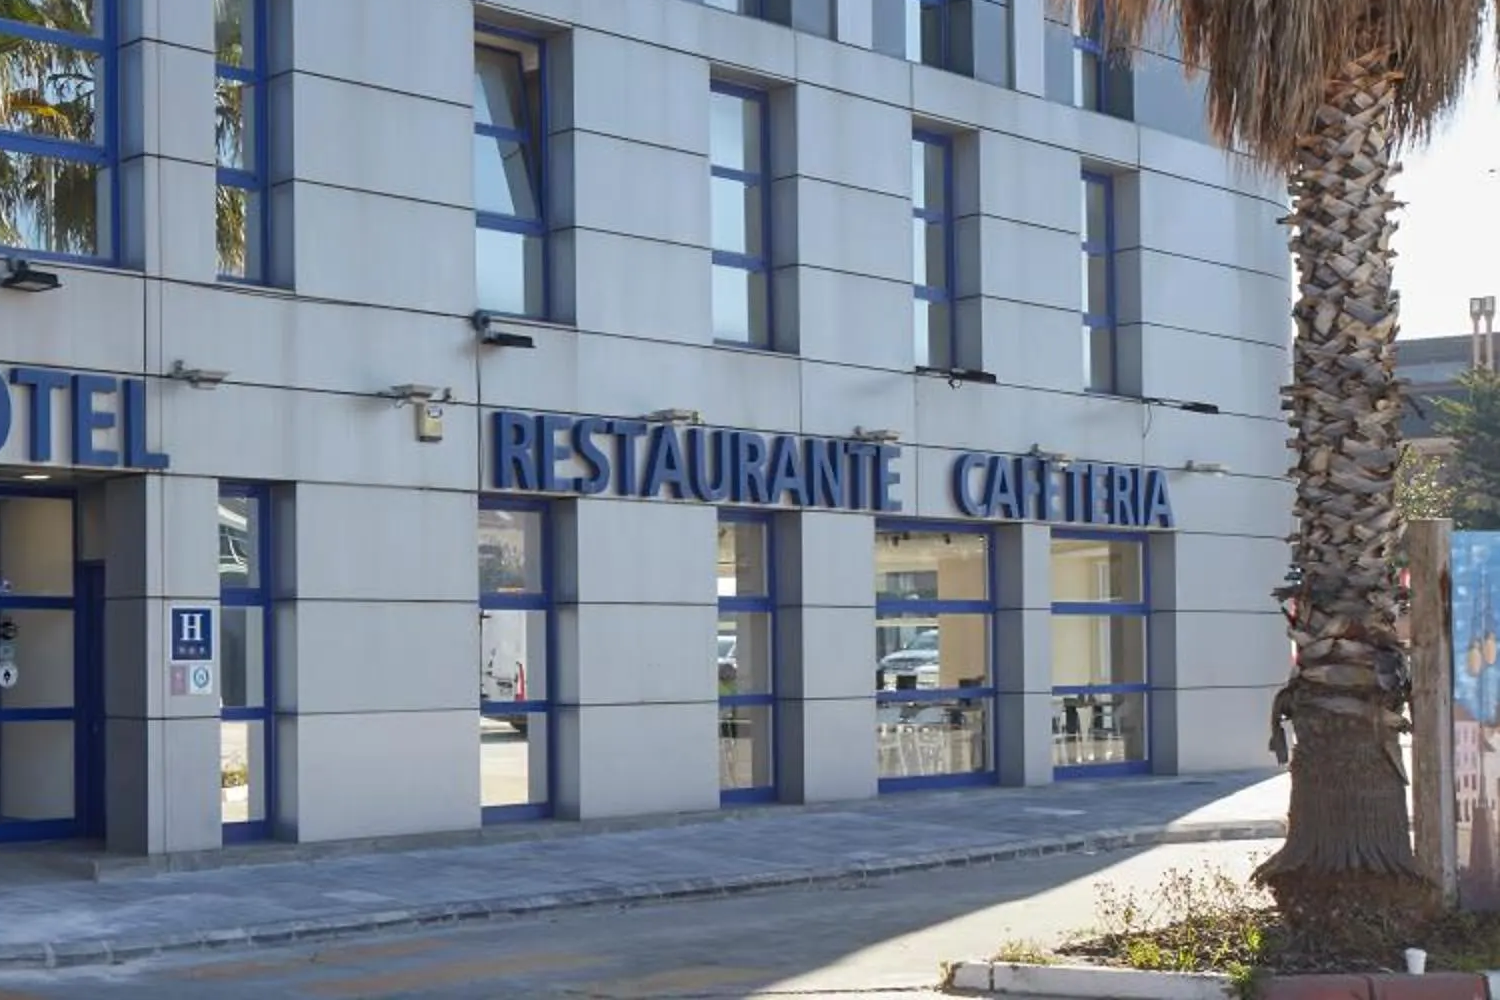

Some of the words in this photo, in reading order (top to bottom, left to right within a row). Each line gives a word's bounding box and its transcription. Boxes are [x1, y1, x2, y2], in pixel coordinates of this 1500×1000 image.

[491, 410, 902, 512] RESTAURANTE
[952, 453, 1176, 528] CAFETERIA
[179, 612, 204, 642] H
